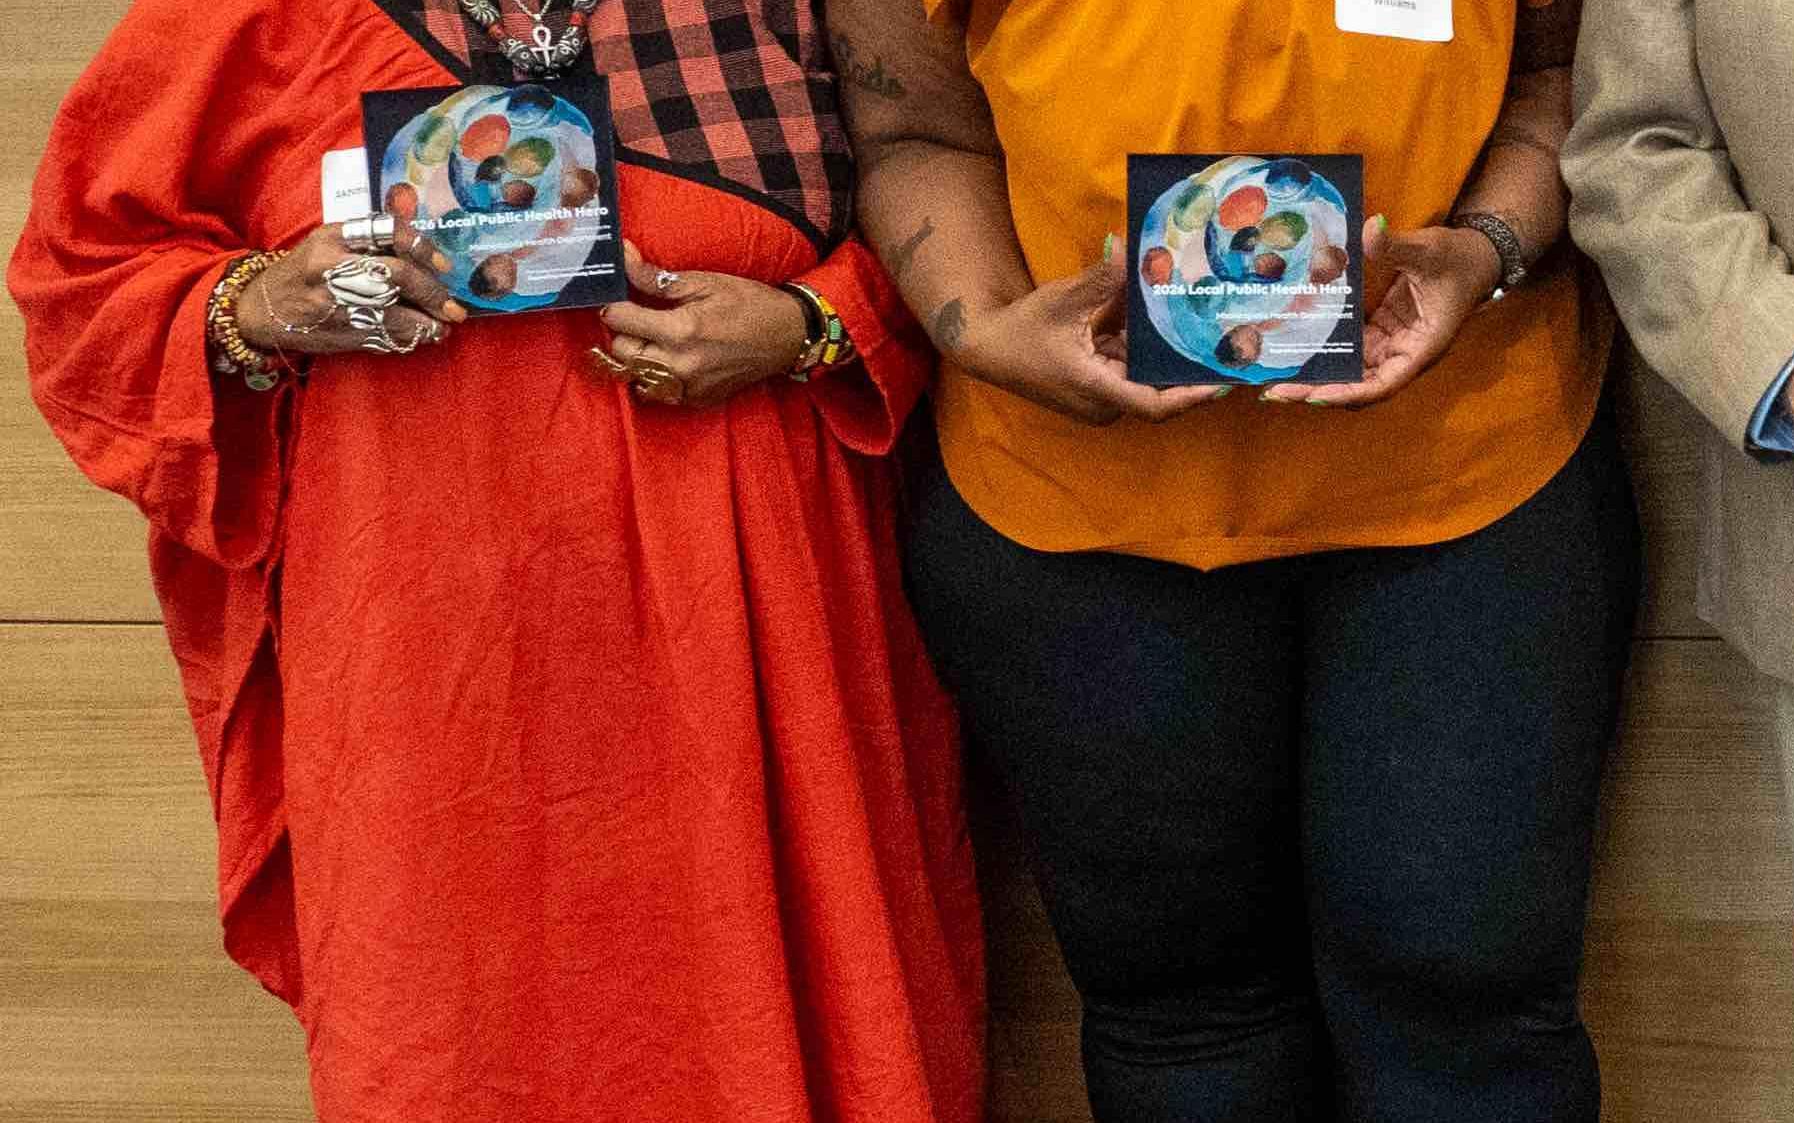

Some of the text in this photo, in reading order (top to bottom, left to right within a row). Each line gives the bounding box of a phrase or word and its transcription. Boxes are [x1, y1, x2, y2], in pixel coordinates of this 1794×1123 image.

[438, 213, 478, 229] Local
[479, 210, 524, 226] Public
[525, 207, 573, 222] Health
[575, 205, 609, 218] Hero
[1188, 283, 1224, 295] Local
[1227, 283, 1268, 295] Public
[1270, 283, 1317, 295] Health
[1319, 283, 1352, 295] Hero
